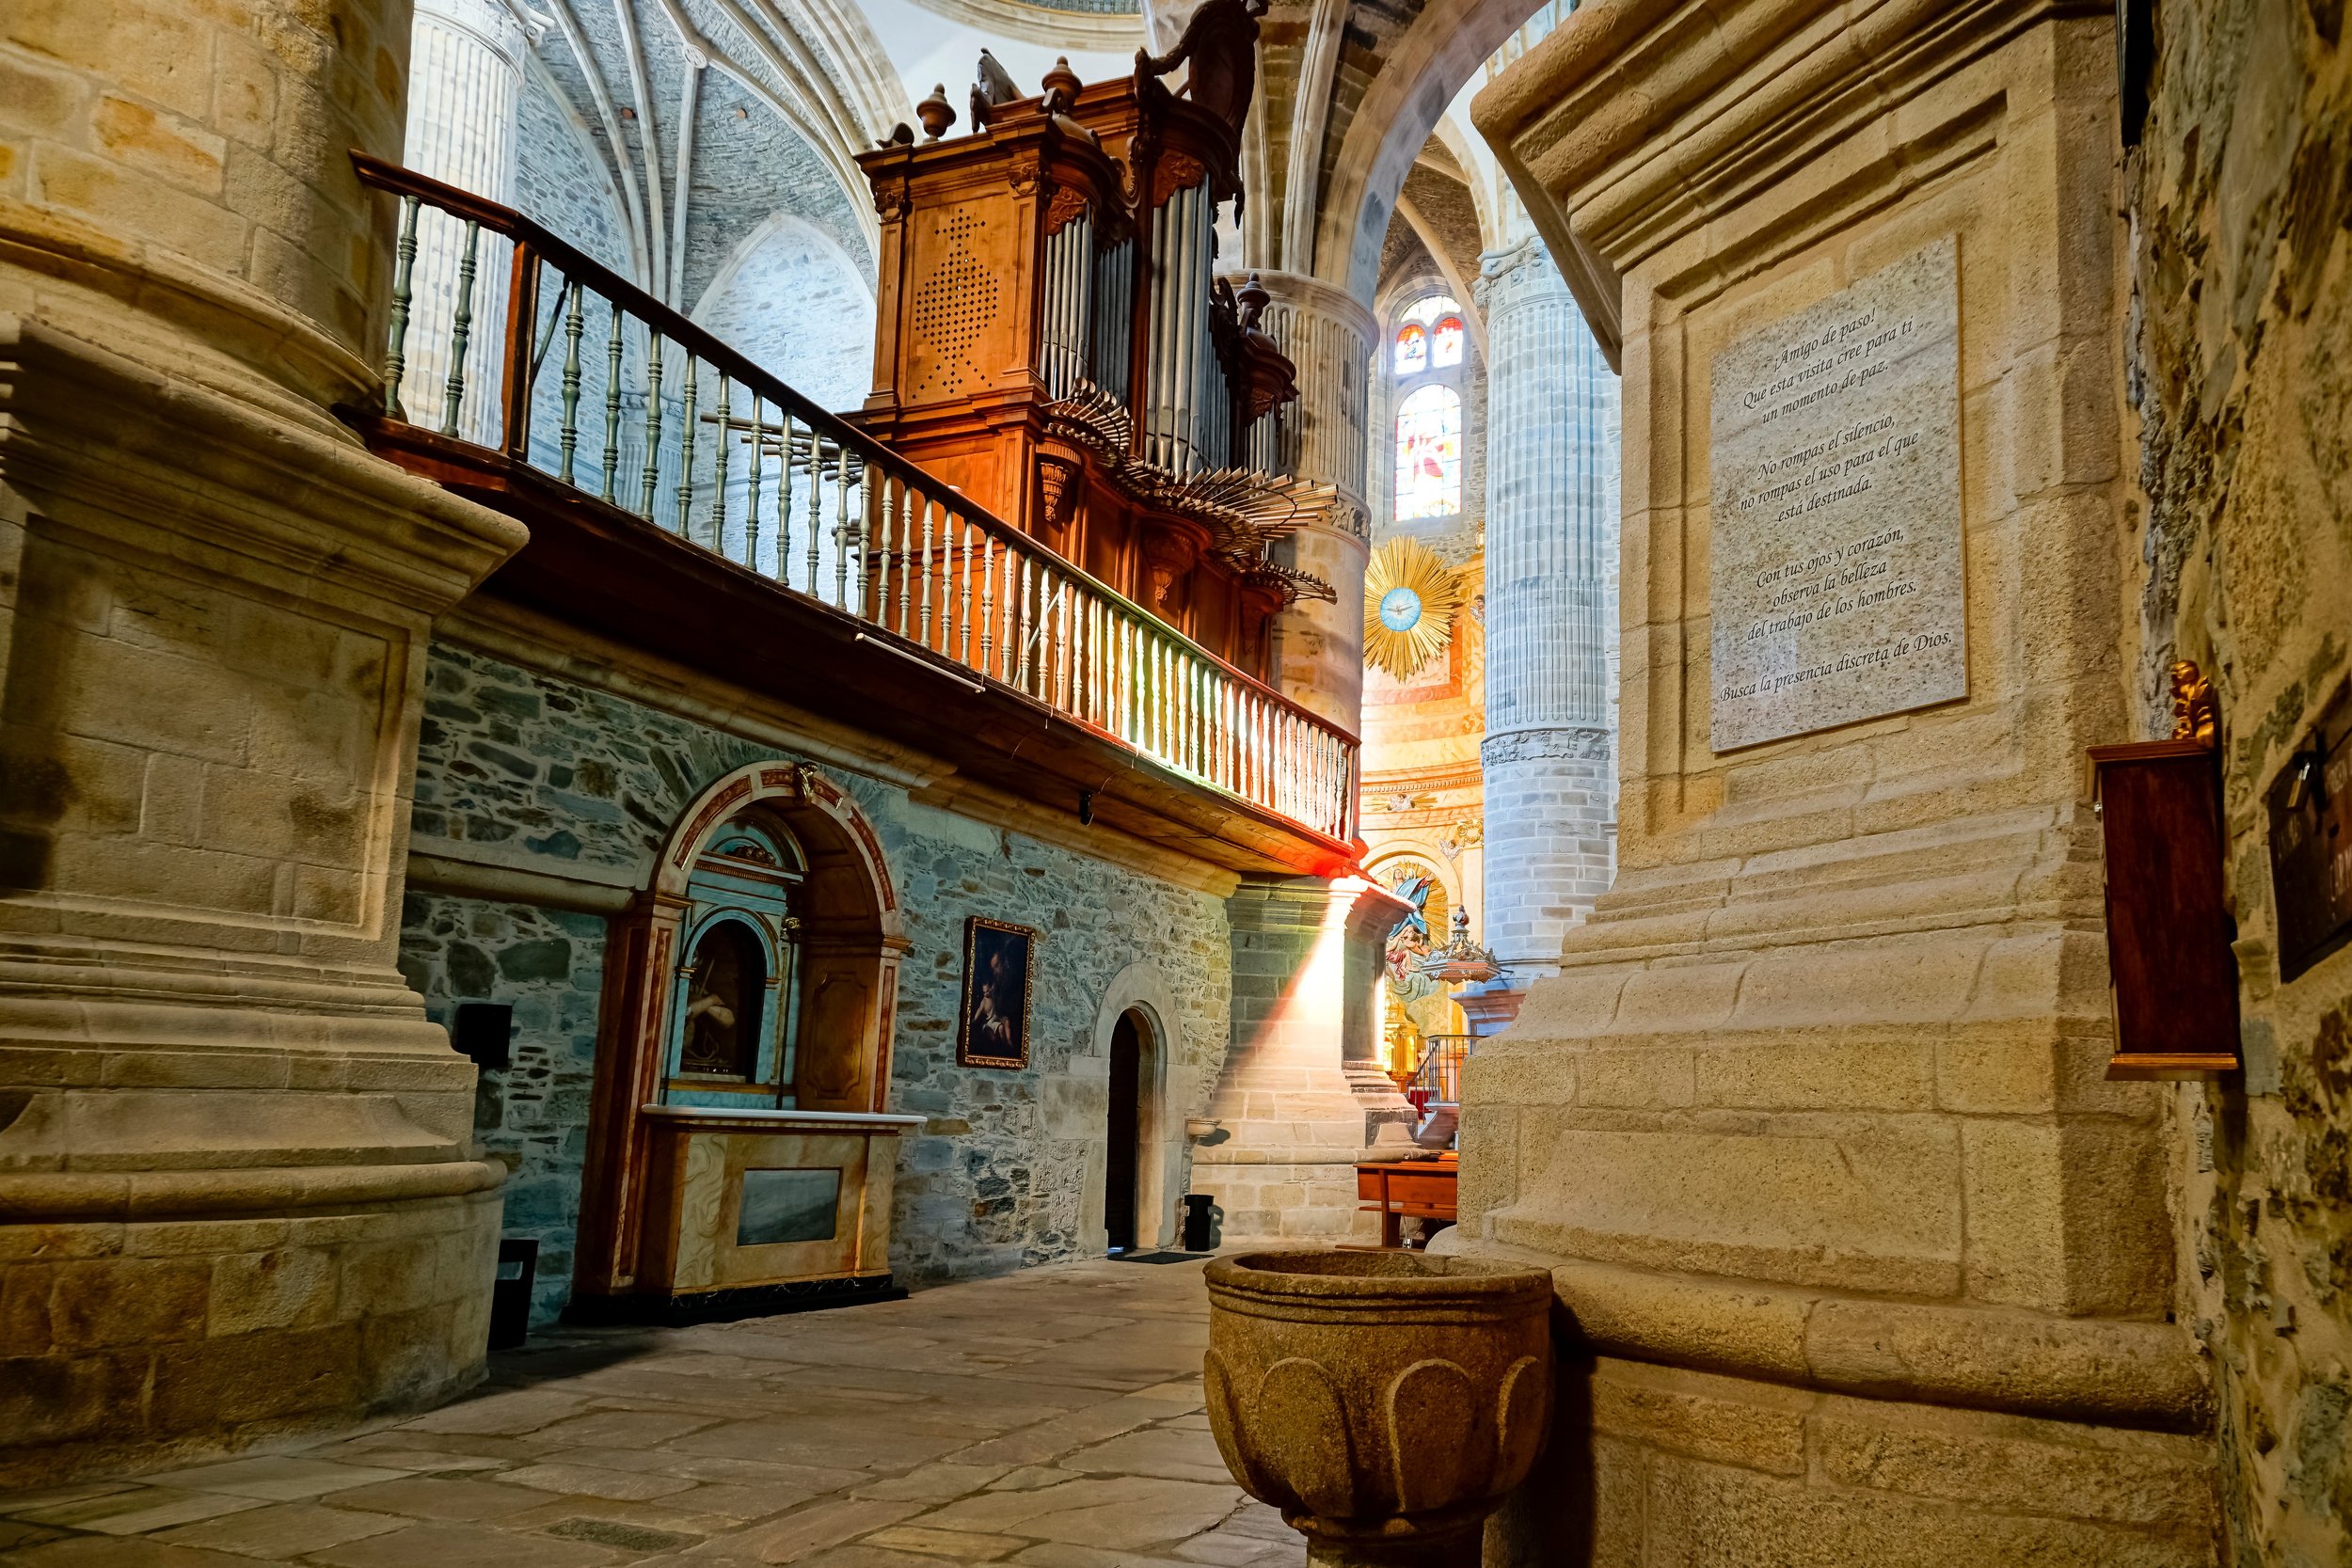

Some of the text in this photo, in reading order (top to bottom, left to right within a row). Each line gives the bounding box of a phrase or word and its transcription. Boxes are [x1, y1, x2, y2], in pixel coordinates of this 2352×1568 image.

[1743, 316, 1914, 407] Que esta visita cree para ti
[1774, 309, 1876, 372] ¡Amigo de paso!
[1762, 361, 1888, 424] un momento de paz.
[1740, 432, 1919, 511] no rompas el uso para el que
[1757, 414, 1895, 480] No rompas el silencio,
[1778, 476, 1872, 521] está destinada.
[1757, 527, 1904, 587] Con tus ojos y corazón,
[1772, 562, 1887, 607] observa la belleza
[1747, 580, 1916, 641] del trabajo de los hombres.
[1721, 632, 1952, 701] Busca la presencia discreta de Dios.
